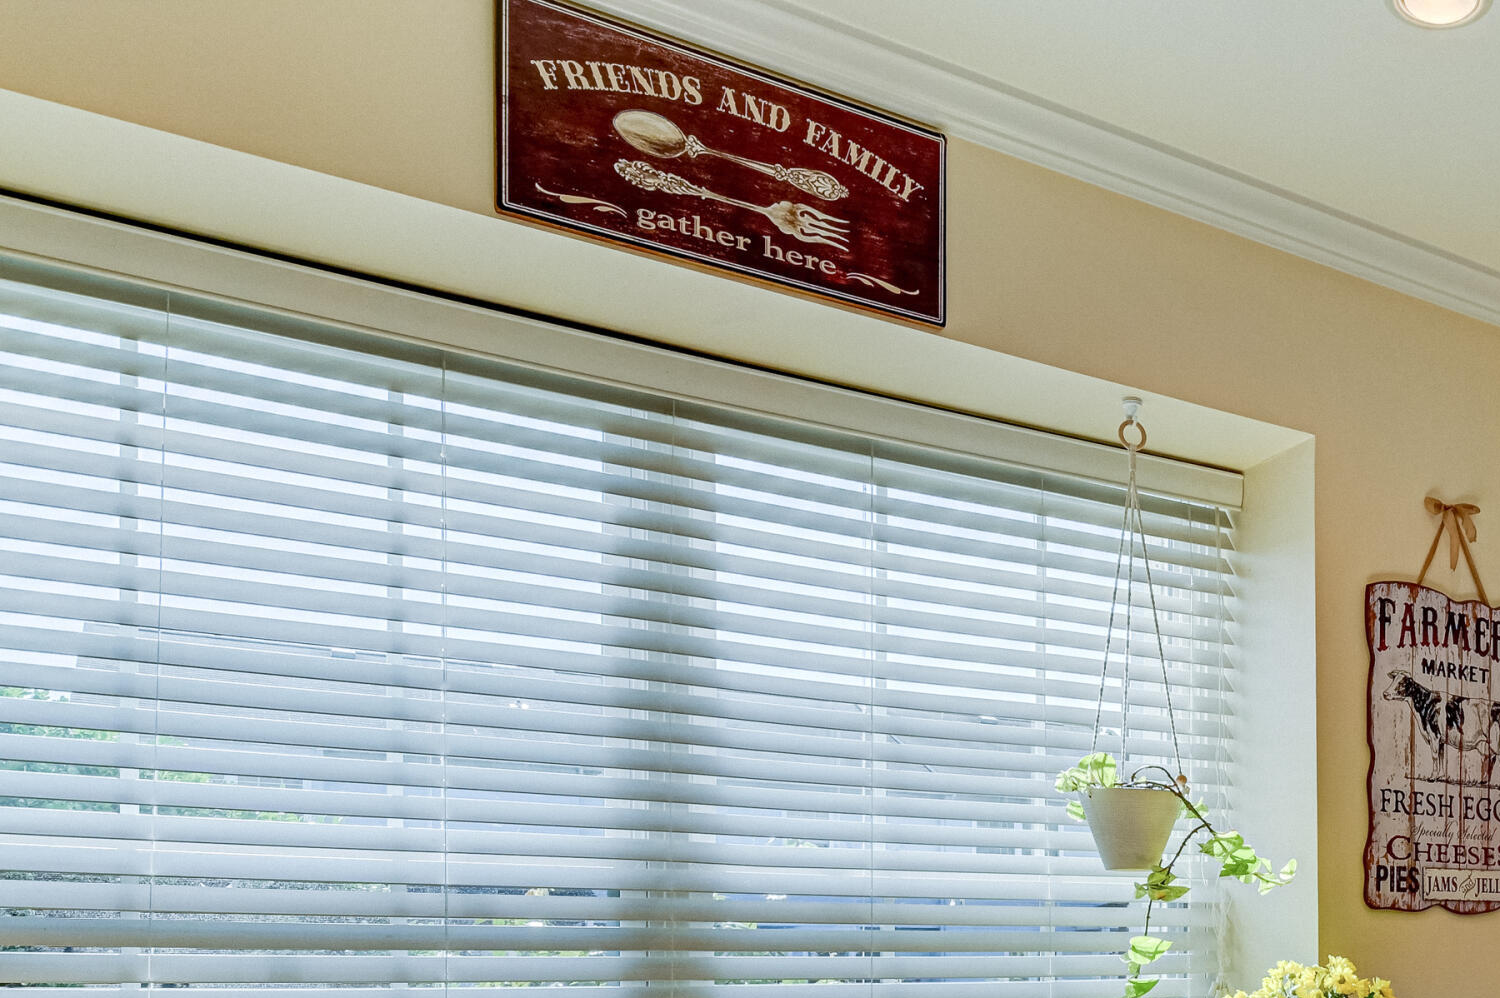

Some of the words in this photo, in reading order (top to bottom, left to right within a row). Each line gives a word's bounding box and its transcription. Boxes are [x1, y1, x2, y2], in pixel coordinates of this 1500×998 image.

[530, 58, 703, 106] FRIENDS
[717, 86, 791, 133] AND
[803, 118, 925, 203] FAMILY
[636, 206, 752, 252] gather
[763, 235, 837, 275] here
[1421, 658, 1490, 684] MARKET
[1380, 788, 1454, 819] FRESH
[1411, 820, 1457, 846] Specially
[1458, 824, 1498, 843] Selected
[1376, 865, 1420, 893] PIES
[1426, 876, 1458, 896] JAMS
[1462, 879, 1474, 893] and
